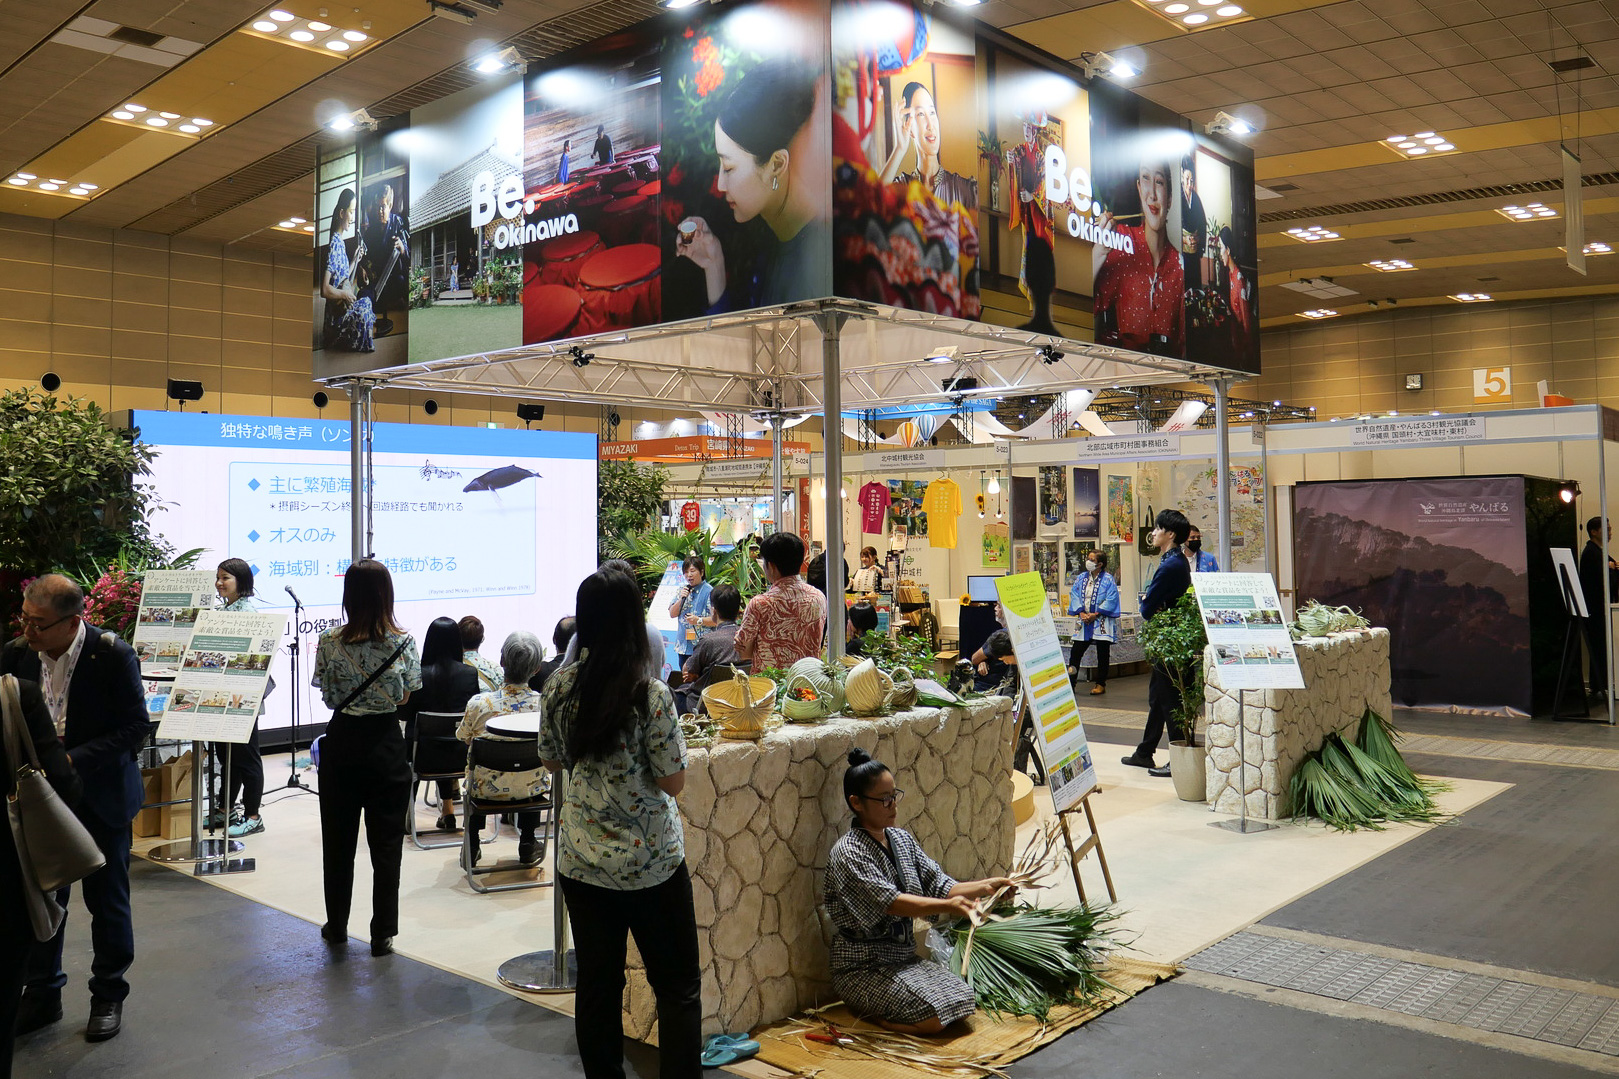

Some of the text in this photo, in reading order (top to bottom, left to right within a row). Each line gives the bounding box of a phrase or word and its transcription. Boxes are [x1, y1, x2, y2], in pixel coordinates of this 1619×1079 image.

[1044, 144, 1101, 218] Be.
[471, 171, 535, 228] Be.
[494, 211, 580, 250] Okinawa
[1068, 212, 1135, 255] Okinawa
[1484, 367, 1507, 397] 5
[1355, 418, 1476, 434] 世界自然遺産・やんばる3村観光協議会
[602, 444, 638, 456] MIYAZAKI
[1469, 502, 1509, 512] やんばる
[269, 527, 336, 543] オスのみ
[207, 619, 274, 628] アンケートに回答して
